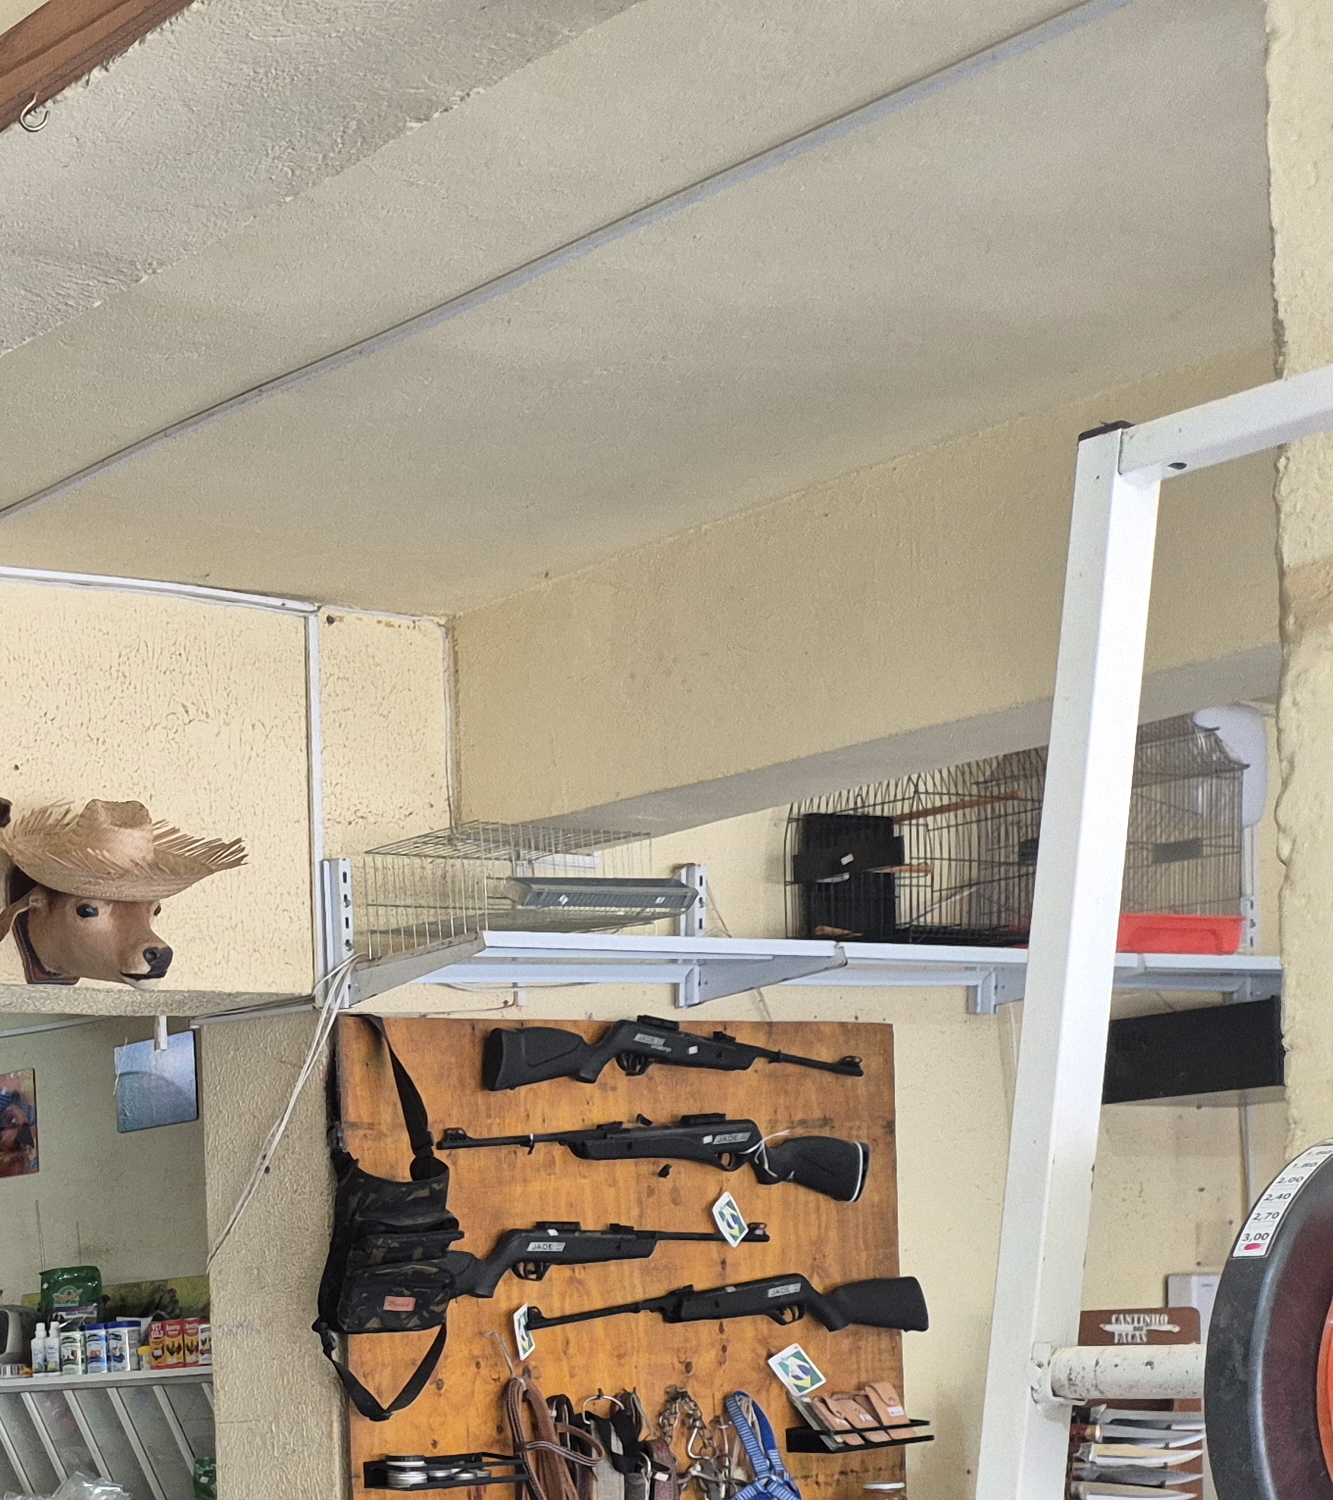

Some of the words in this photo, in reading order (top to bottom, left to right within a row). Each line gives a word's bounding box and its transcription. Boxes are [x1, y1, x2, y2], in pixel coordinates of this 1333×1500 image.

[1292, 1161, 1318, 1169] 1,80
[1276, 1175, 1304, 1184] 2,00
[1263, 1192, 1292, 1201] 2,40
[1252, 1211, 1280, 1221] 2,70
[1241, 1232, 1270, 1242] 3,00
